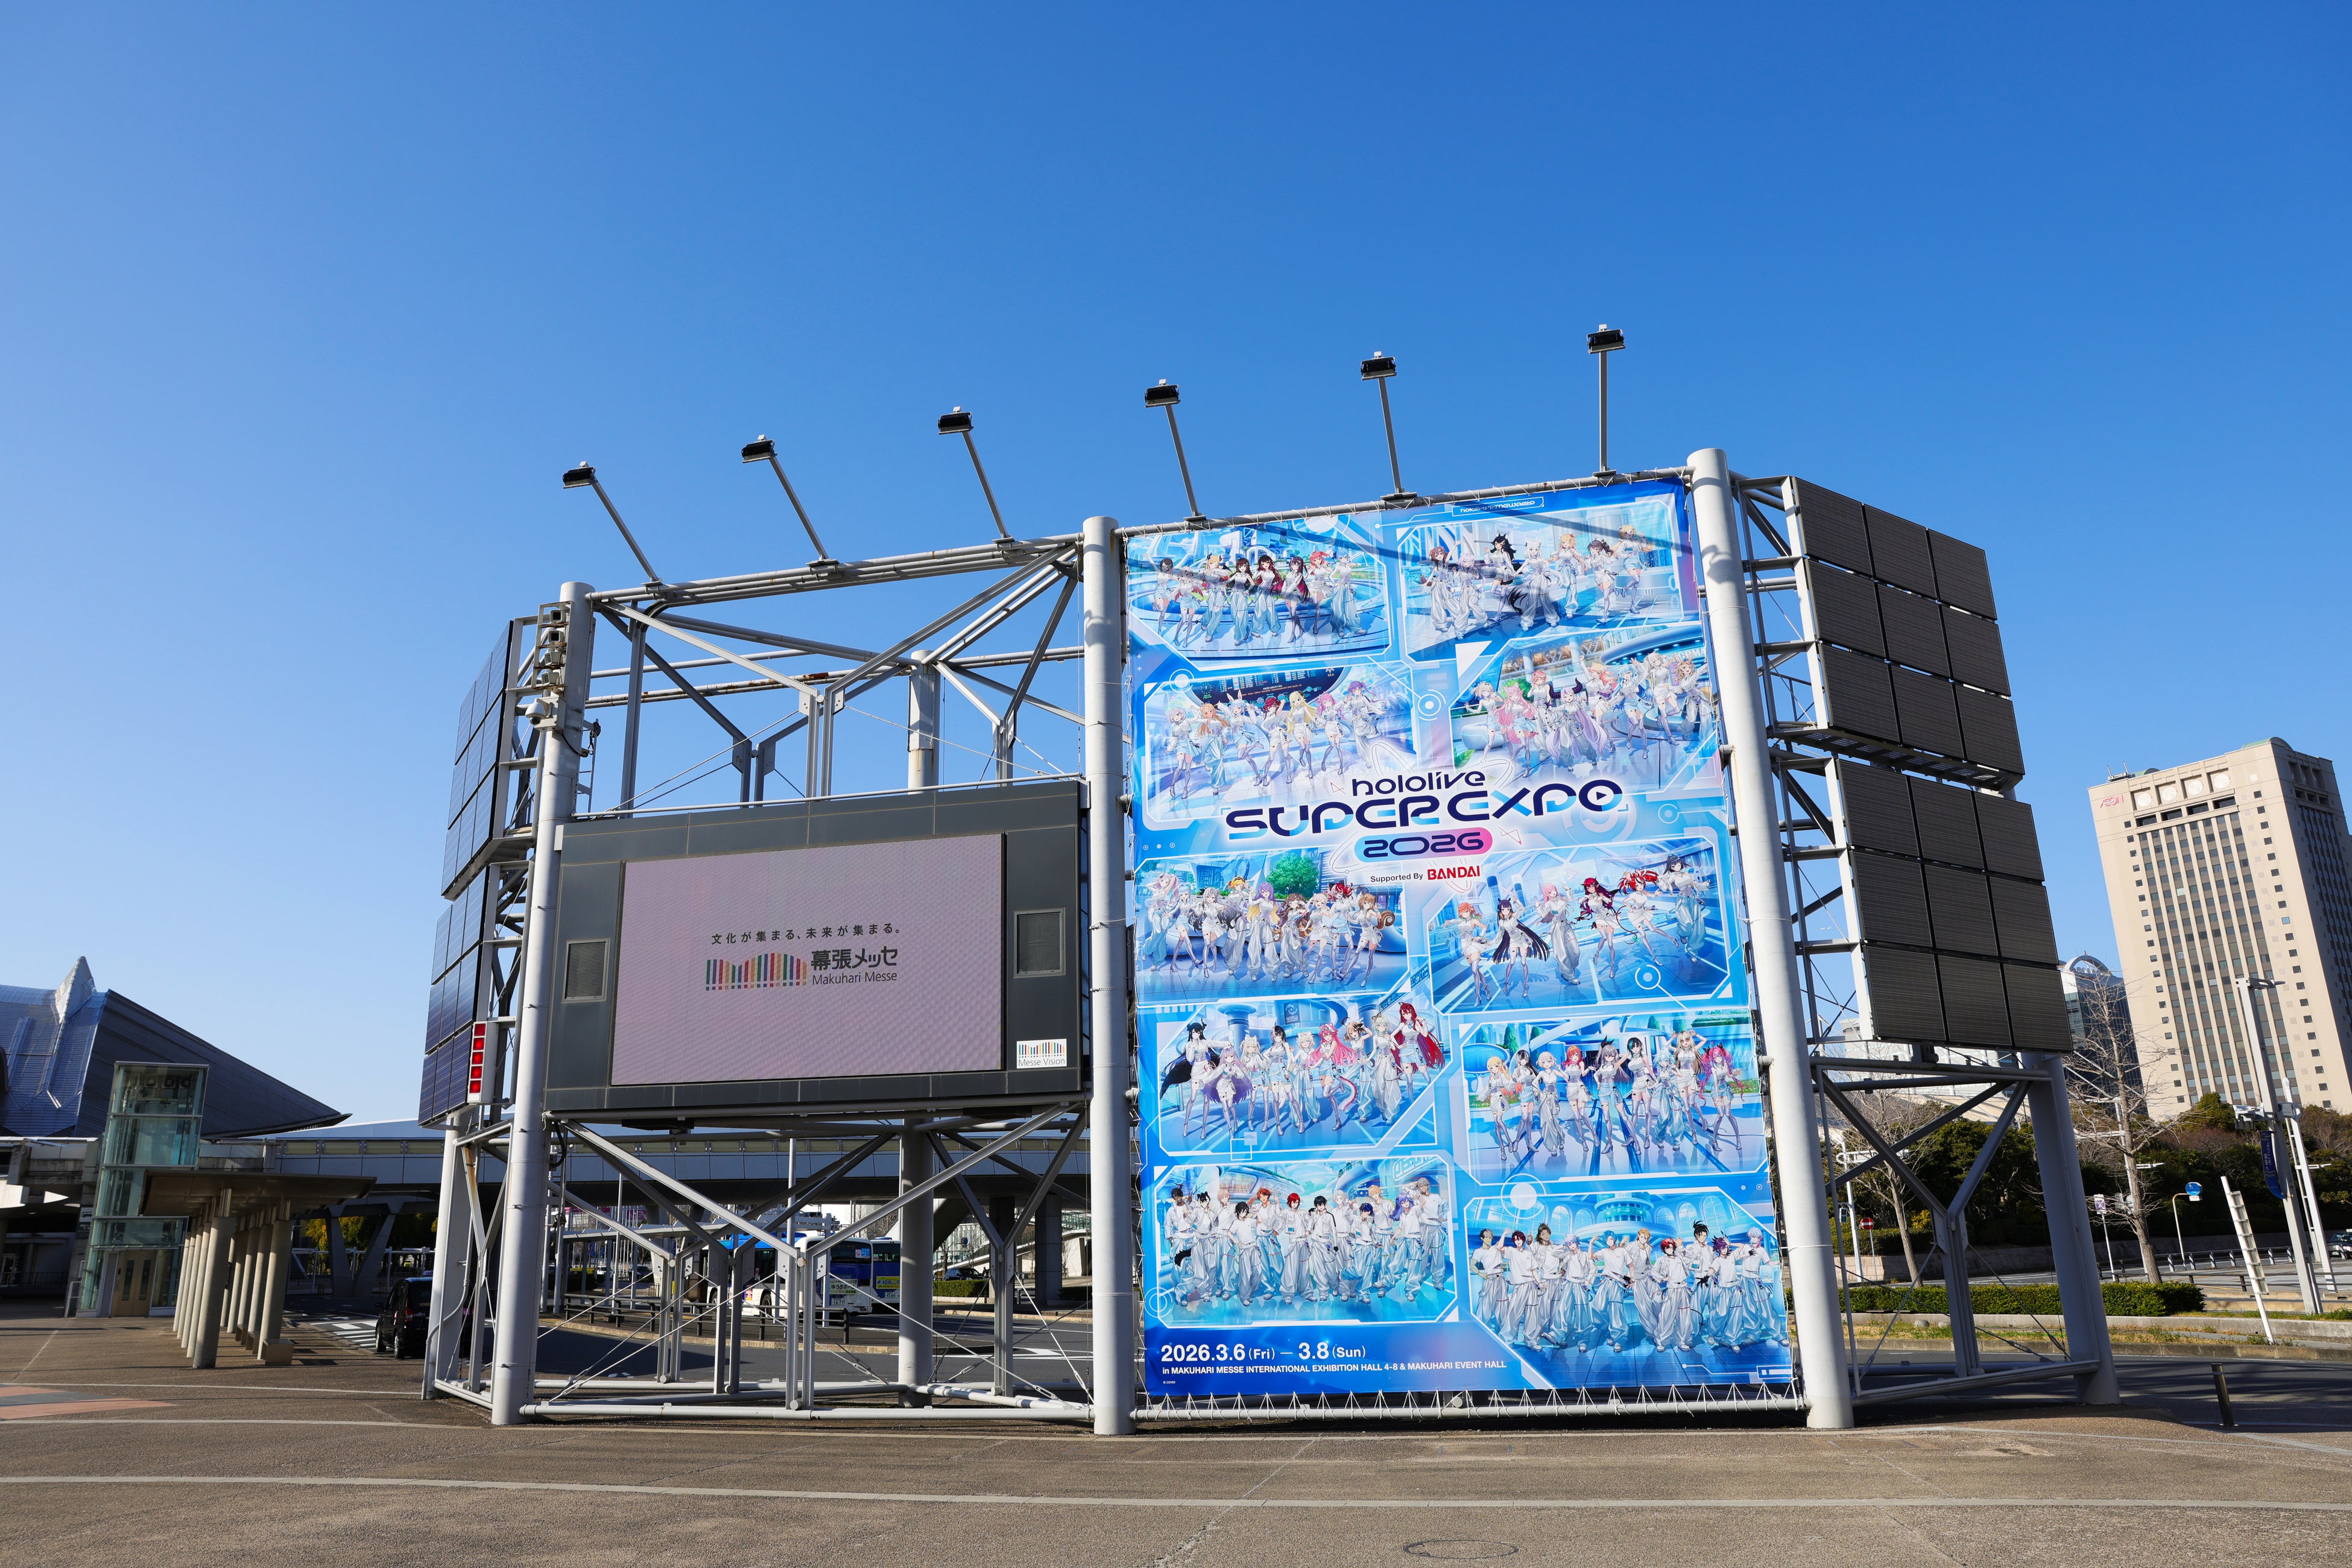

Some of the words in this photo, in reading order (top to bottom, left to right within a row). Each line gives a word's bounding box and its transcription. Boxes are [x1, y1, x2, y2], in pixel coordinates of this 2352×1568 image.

[1352, 771, 1486, 797] hololive
[1225, 795, 1440, 840] SUPER
[1447, 779, 1623, 822] EXPO
[1364, 832, 1484, 858] 2026
[1370, 874, 1412, 883] Supported
[1427, 865, 1481, 880] BANDAI
[712, 923, 900, 945] 文化が集まる、未来が集まる。
[811, 946, 898, 971] 幕張メッセ
[812, 972, 861, 985] Makuhari
[865, 972, 897, 983] Messe
[1161, 1343, 1245, 1362] 2026.3.6
[1248, 1347, 1276, 1361] (Fri)
[1298, 1340, 1329, 1360] 3.8
[1332, 1345, 1366, 1359] (Sun)
[1171, 1366, 1214, 1374] MAKUHARI
[1246, 1365, 1310, 1374] INTERNATIONAL
[1312, 1364, 1359, 1373] EXHIBITION
[1361, 1363, 1383, 1371] HALL
[1407, 1361, 1453, 1370] MAKUHARI
[1454, 1360, 1483, 1369] EVENT
[1484, 1360, 1507, 1368] HALL
